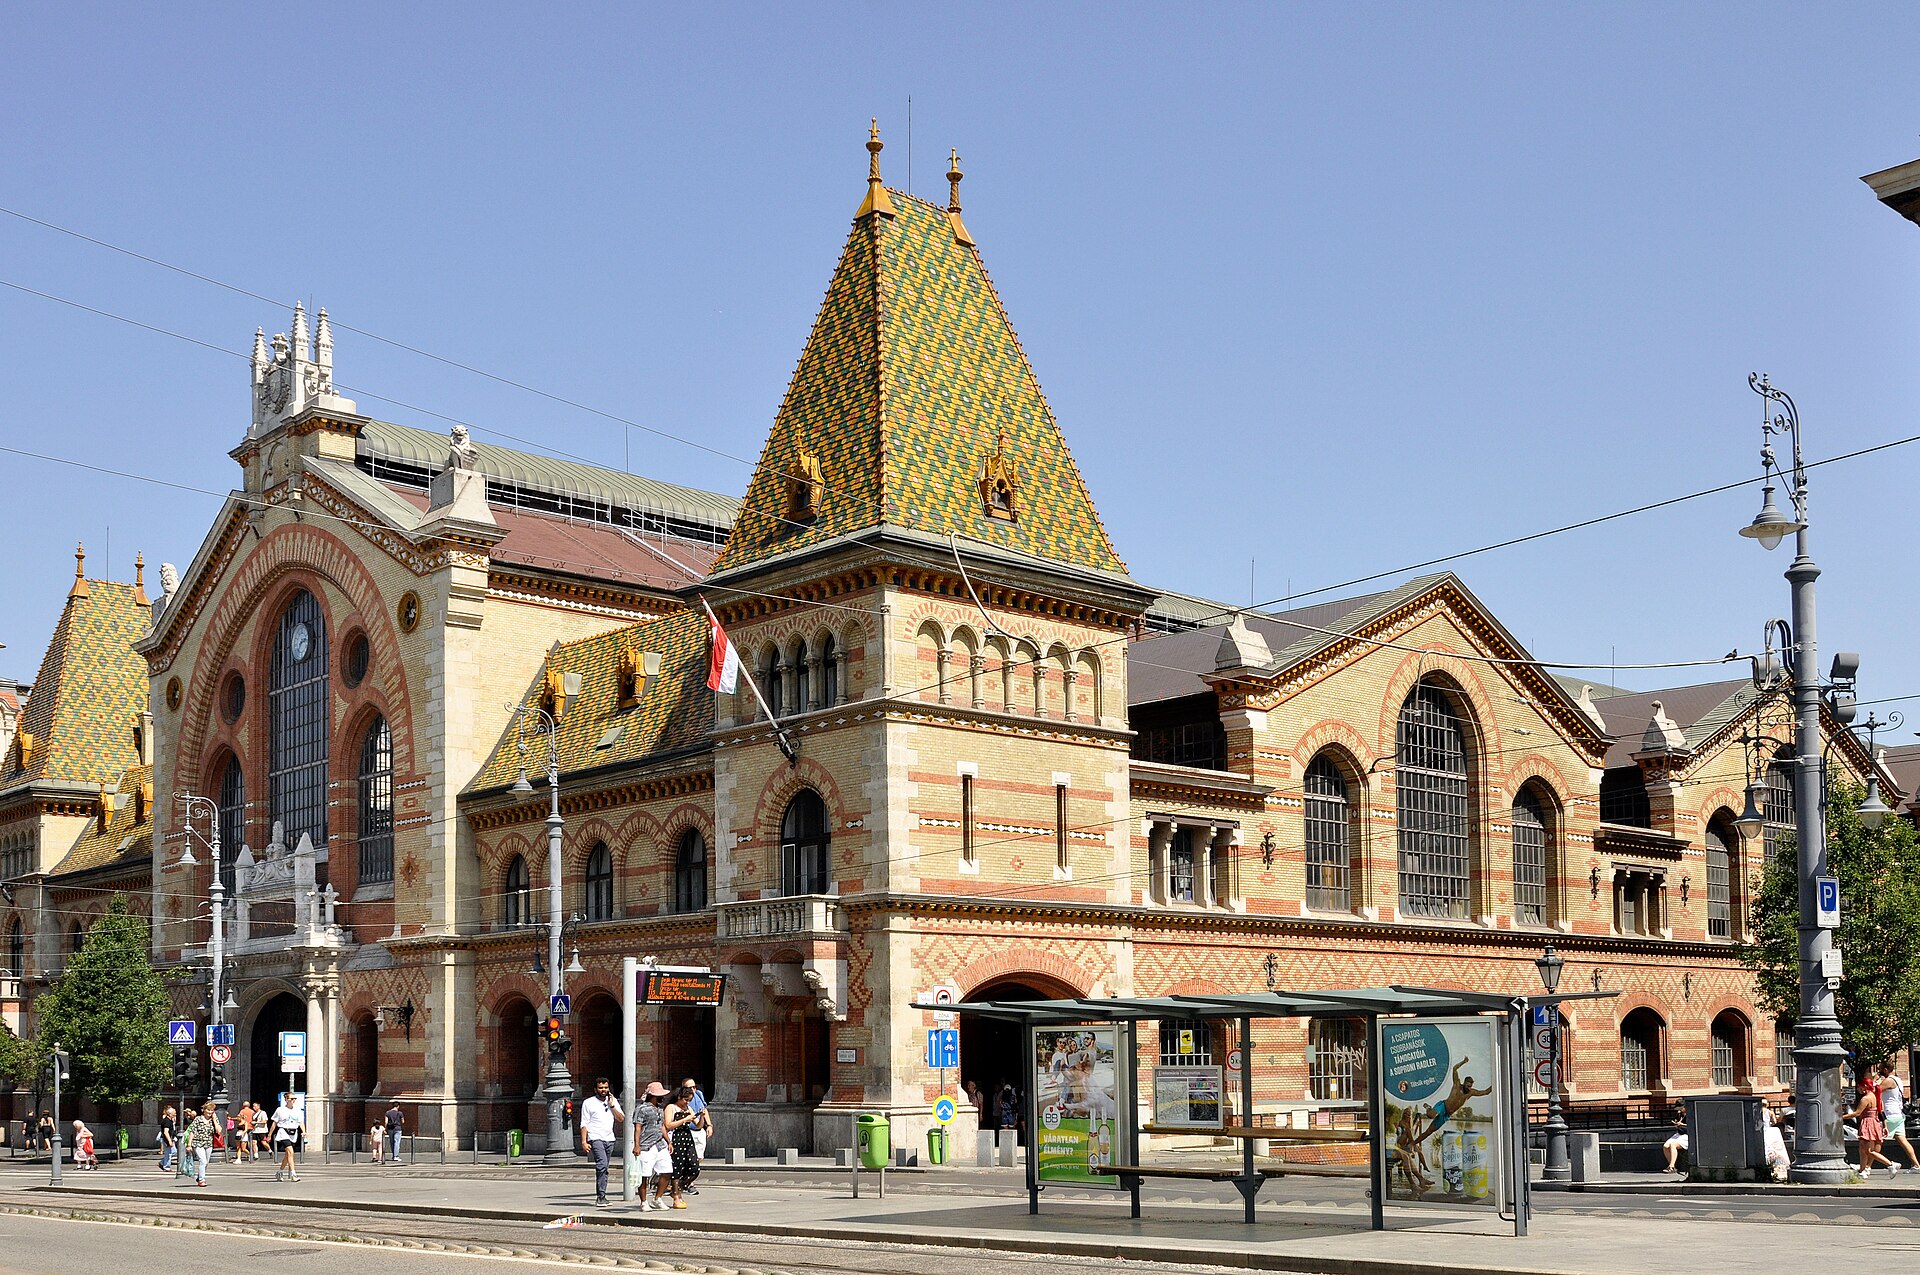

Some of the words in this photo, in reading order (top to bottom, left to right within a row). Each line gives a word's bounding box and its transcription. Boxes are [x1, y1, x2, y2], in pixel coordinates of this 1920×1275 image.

[1824, 886, 1832, 908] P
[1395, 1029, 1420, 1042] CSAPATOS
[1390, 1038, 1426, 1054] CSOBBANÁSOK
[1394, 1049, 1426, 1064] TÁMOGATÓJA
[1390, 1068, 1394, 1076] A
[1394, 1062, 1416, 1076] SOPRONI
[1416, 1058, 1437, 1070] RADLER
[1044, 1133, 1079, 1144] VÁRATLAN
[1044, 1144, 1073, 1154] ÉLMÉNY?
